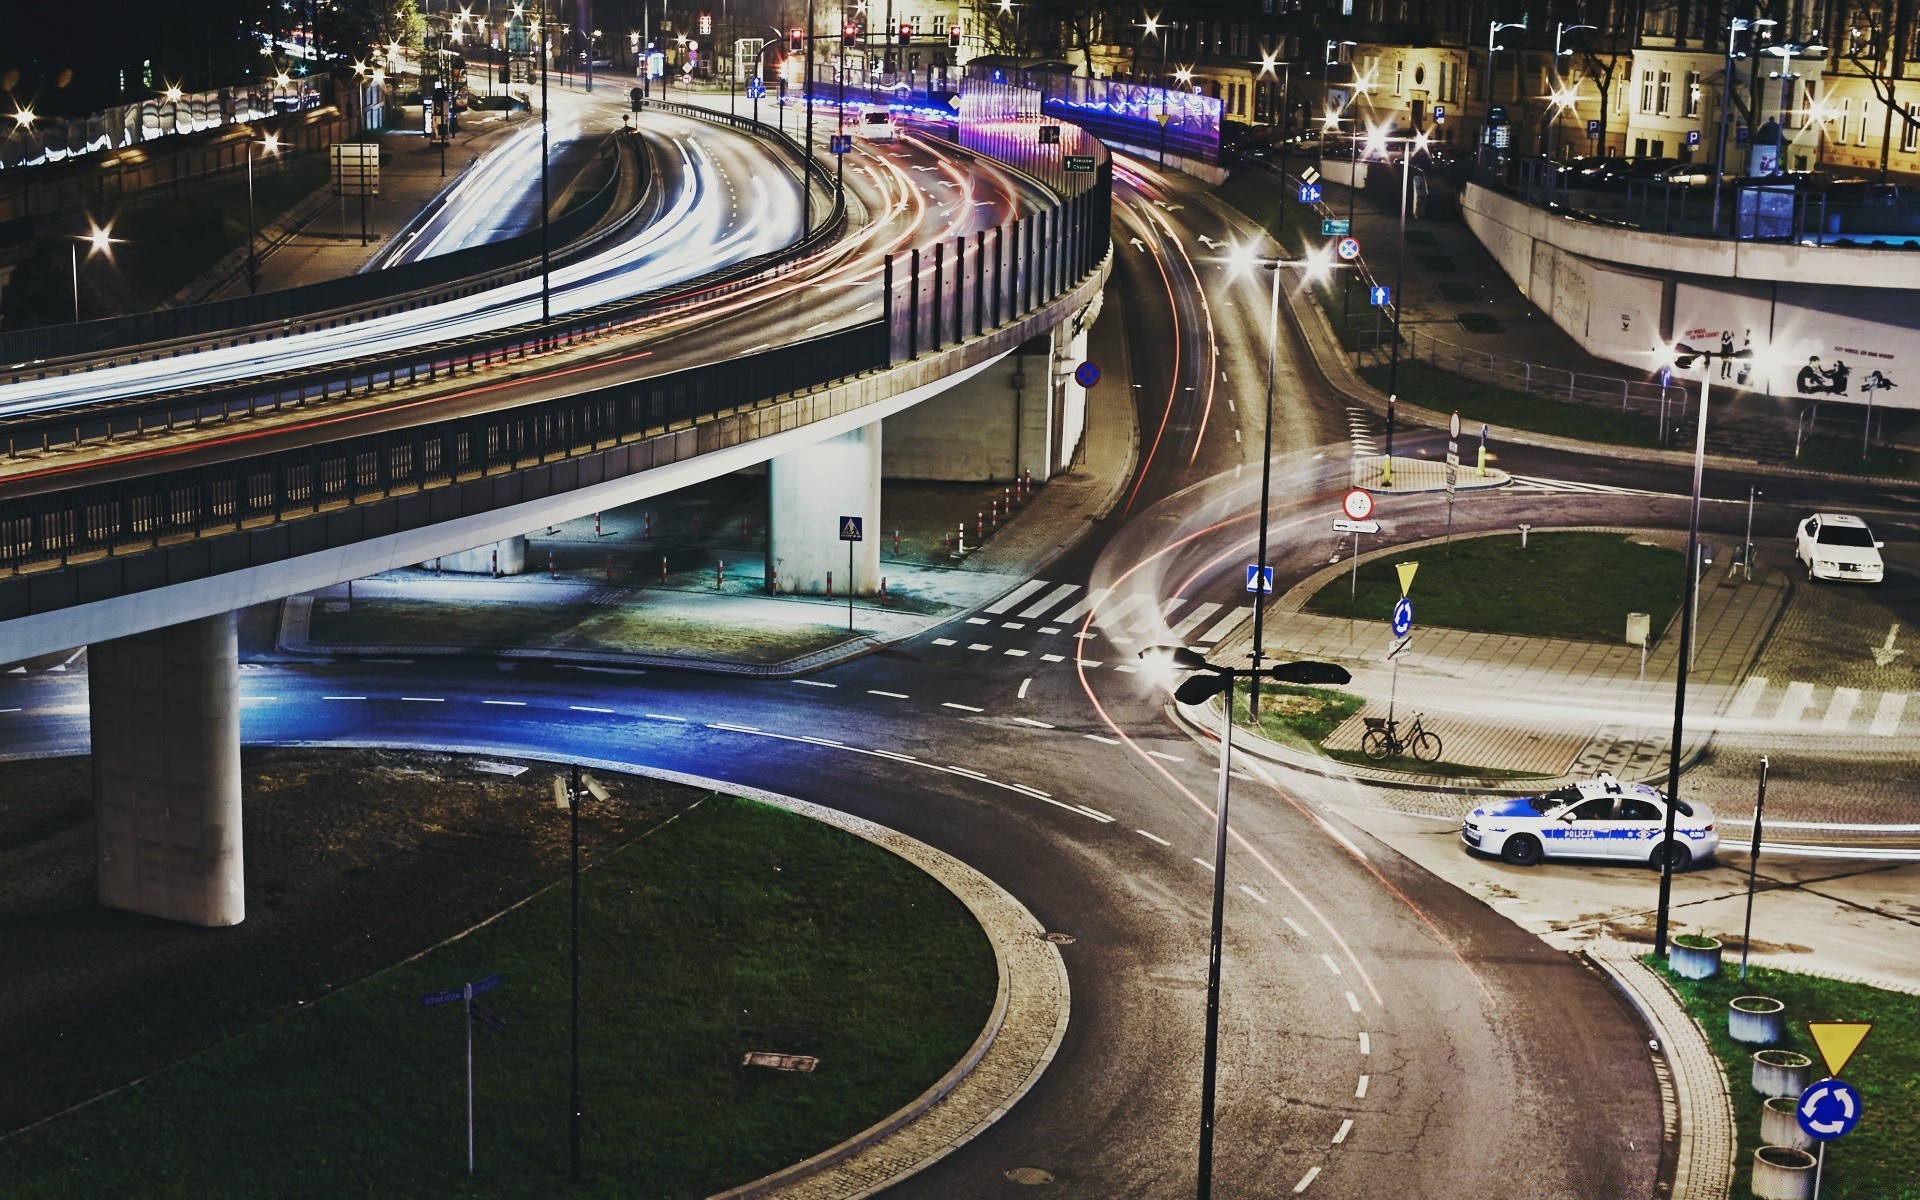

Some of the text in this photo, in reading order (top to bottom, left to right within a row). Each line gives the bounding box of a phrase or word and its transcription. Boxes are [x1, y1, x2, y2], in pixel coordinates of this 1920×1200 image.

[1436, 107, 1443, 116] P
[1590, 121, 1597, 131] P
[1690, 132, 1698, 143] P
[1564, 830, 1595, 838] POLICJA
[425, 993, 460, 1005] STWOSZA
